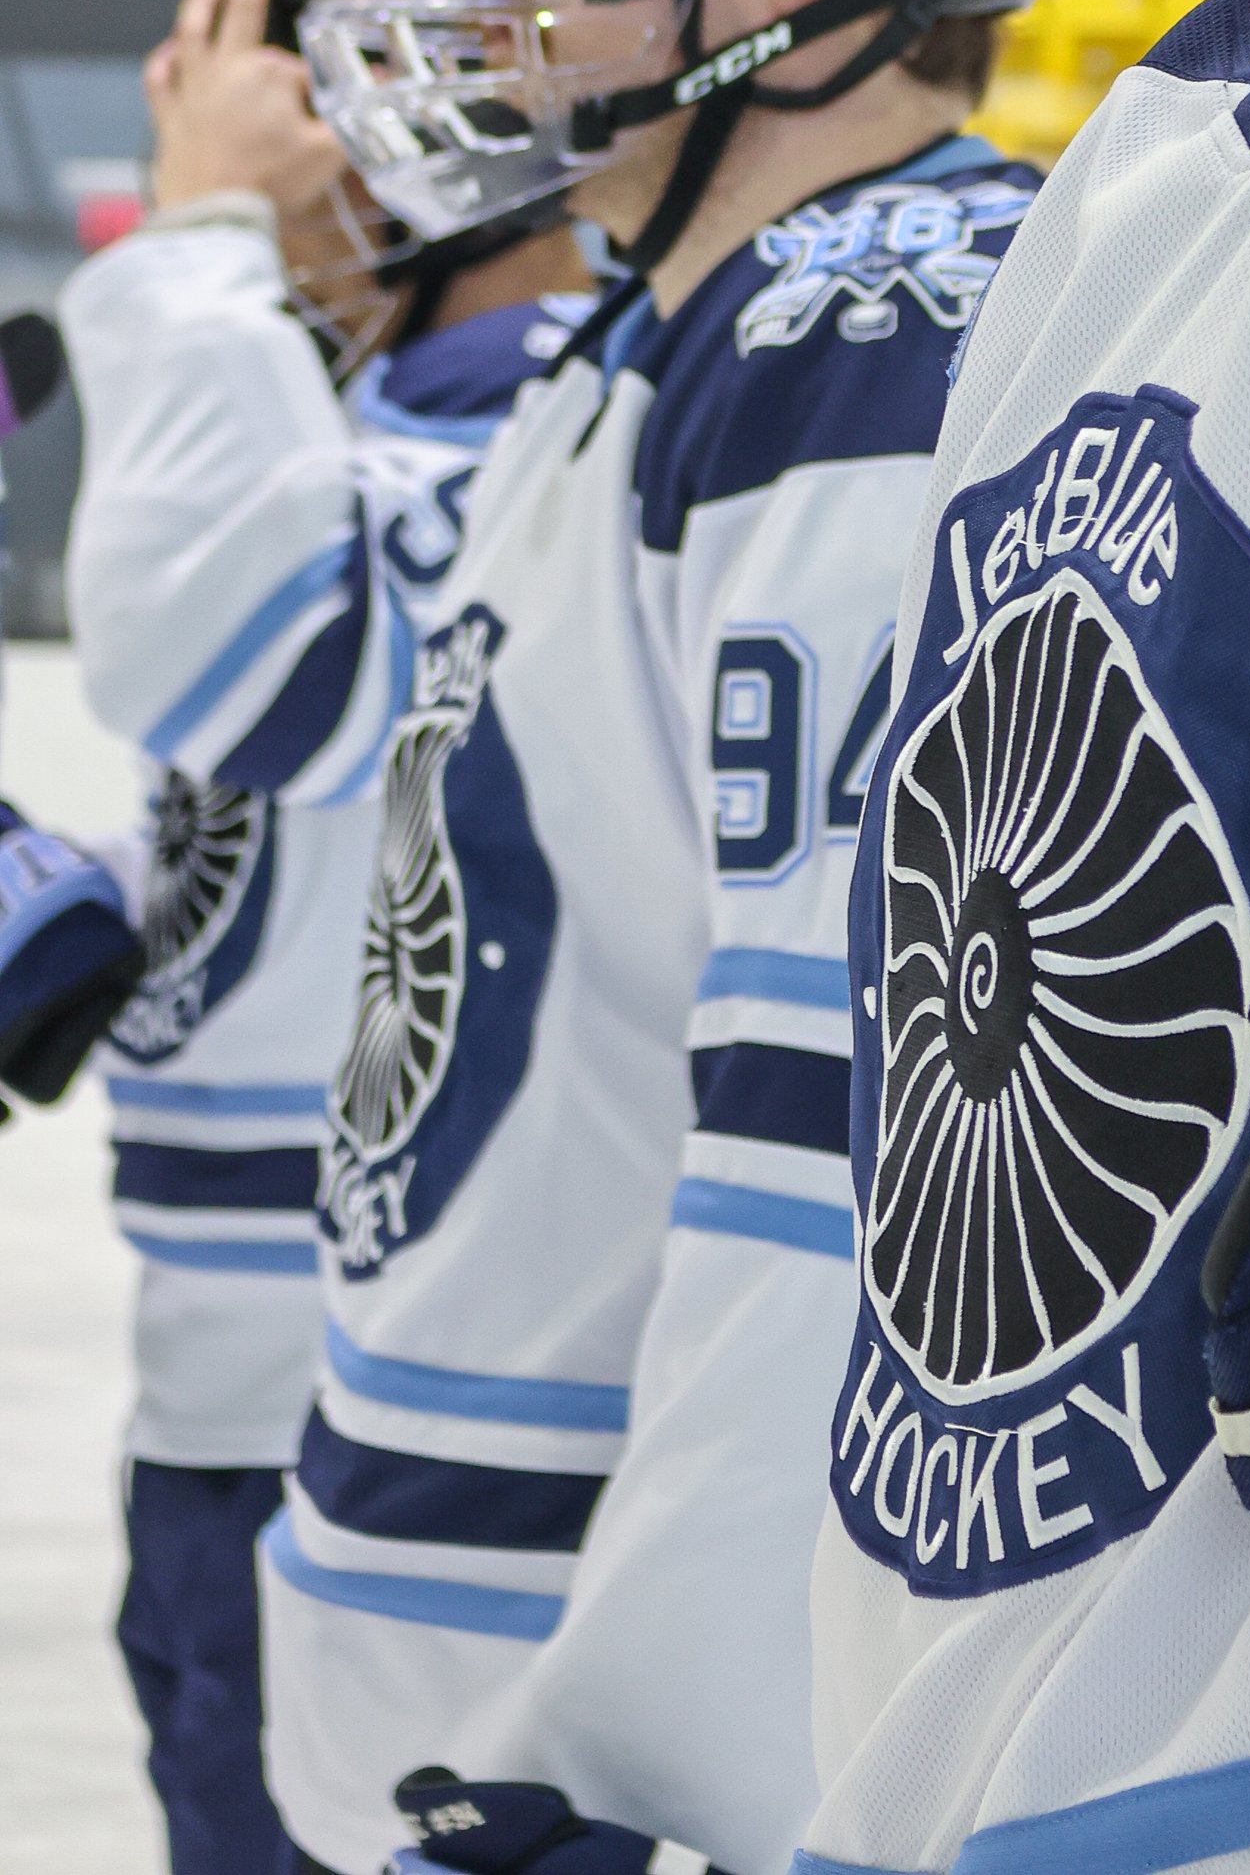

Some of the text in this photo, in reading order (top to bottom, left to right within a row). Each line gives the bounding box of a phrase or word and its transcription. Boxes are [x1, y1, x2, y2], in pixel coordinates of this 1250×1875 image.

[673, 21, 792, 106] CCM
[942, 418, 1180, 666] JetBlue
[838, 1340, 1167, 1570] HOCKEY
